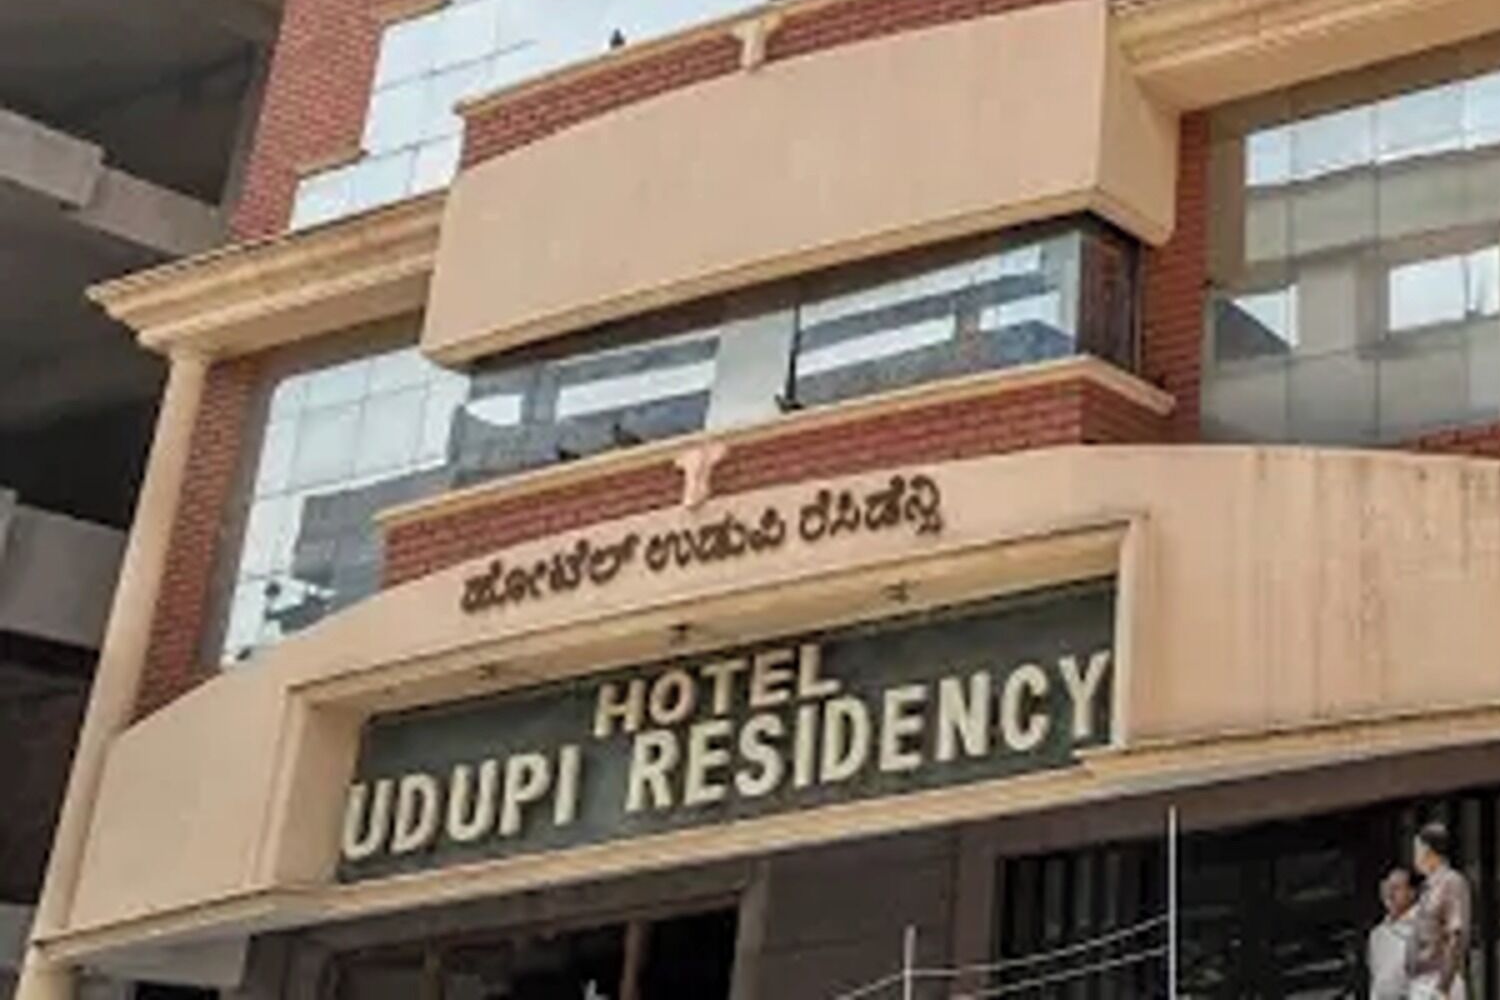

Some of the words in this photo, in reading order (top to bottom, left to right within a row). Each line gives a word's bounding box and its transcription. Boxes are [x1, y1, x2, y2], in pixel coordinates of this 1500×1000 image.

[460, 533, 641, 615] ಹೋಟೆಲ್
[645, 507, 787, 573] ಉಡುಪಿ
[596, 645, 840, 737] HOTEL
[341, 747, 579, 860] UDUPI
[624, 650, 1110, 812] RESIDENCY
